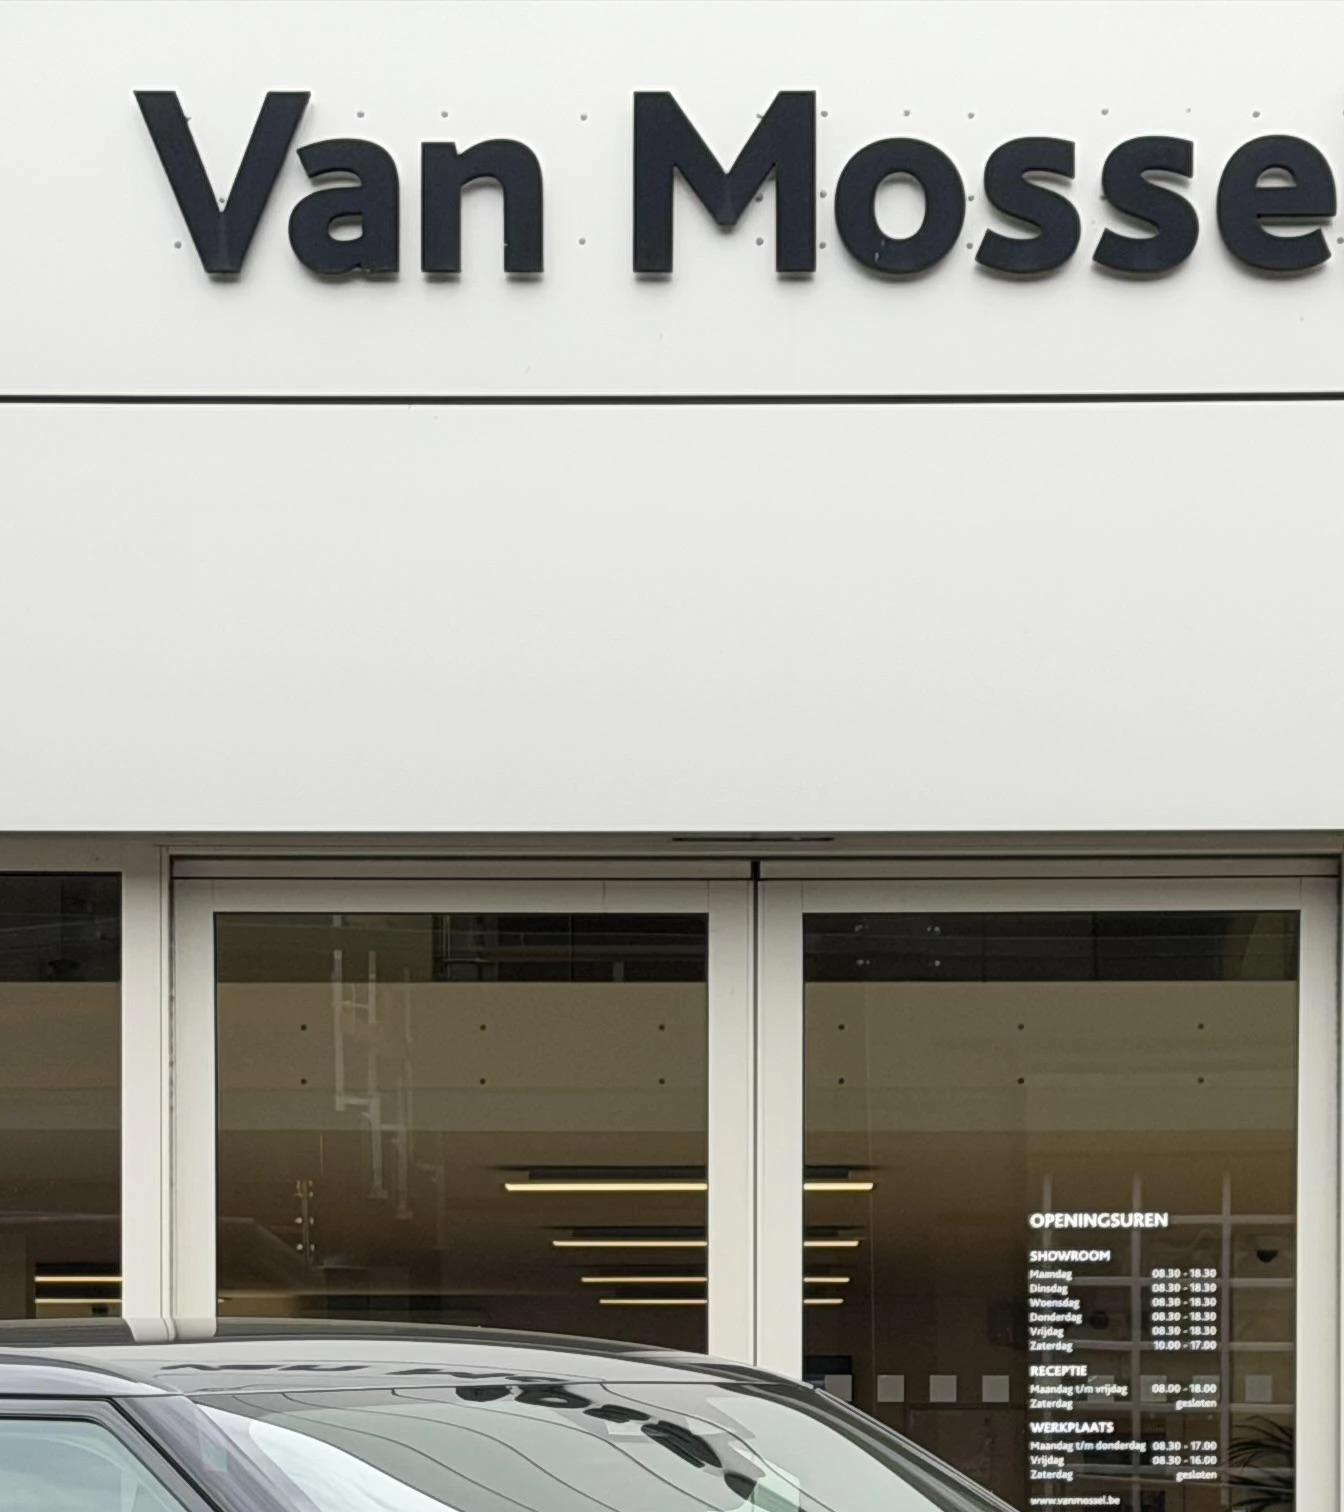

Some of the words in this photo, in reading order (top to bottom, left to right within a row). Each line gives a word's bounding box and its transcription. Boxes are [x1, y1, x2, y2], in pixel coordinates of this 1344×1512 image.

[133, 90, 544, 276] Van
[1029, 1212, 1169, 1228] OPENINGSUREN
[1029, 1250, 1111, 1262] SHOWROOM
[1152, 1269, 1181, 1278] 08.30
[1190, 1269, 1217, 1278] 18.30
[1029, 1284, 1068, 1295] Dinsdag
[1152, 1283, 1181, 1292] 08.30
[1190, 1283, 1217, 1292] 18.30
[1029, 1298, 1080, 1310] Woensdag
[1152, 1298, 1181, 1307] 08.30
[1190, 1298, 1217, 1307] 18.30
[1029, 1312, 1082, 1324] Donderdag
[1152, 1312, 1181, 1321] 08.30
[1190, 1312, 1217, 1321] 18.30
[1029, 1326, 1064, 1338] Vrijdag
[1152, 1326, 1181, 1336] 08.30
[1190, 1326, 1217, 1336] 18.30
[1029, 1341, 1073, 1352] Zaterdag
[1154, 1341, 1181, 1350] 10.00
[1190, 1341, 1217, 1350] 17.00
[1029, 1365, 1088, 1376] RECEPTIE
[1029, 1384, 1073, 1396] Maandag
[1095, 1384, 1128, 1396] vrijdag
[1152, 1384, 1181, 1393] 08.00
[1190, 1384, 1217, 1393] 18.00
[1029, 1399, 1073, 1410] Zaterdag
[1176, 1399, 1217, 1410] gesloten
[1029, 1422, 1114, 1434] WERKPLAATS
[1029, 1441, 1074, 1452] Maandag
[1096, 1441, 1146, 1453] donderdag
[1152, 1441, 1181, 1450] 08.30
[1190, 1441, 1217, 1450] 17.00
[1029, 1456, 1064, 1467] Vrijdag
[1152, 1456, 1181, 1464] 08.30
[1190, 1456, 1217, 1464] 16.00
[1029, 1470, 1073, 1482] Zaterdag
[1176, 1470, 1217, 1482] gesloten
[1030, 1496, 1120, 1506] www.vanmossel.be
